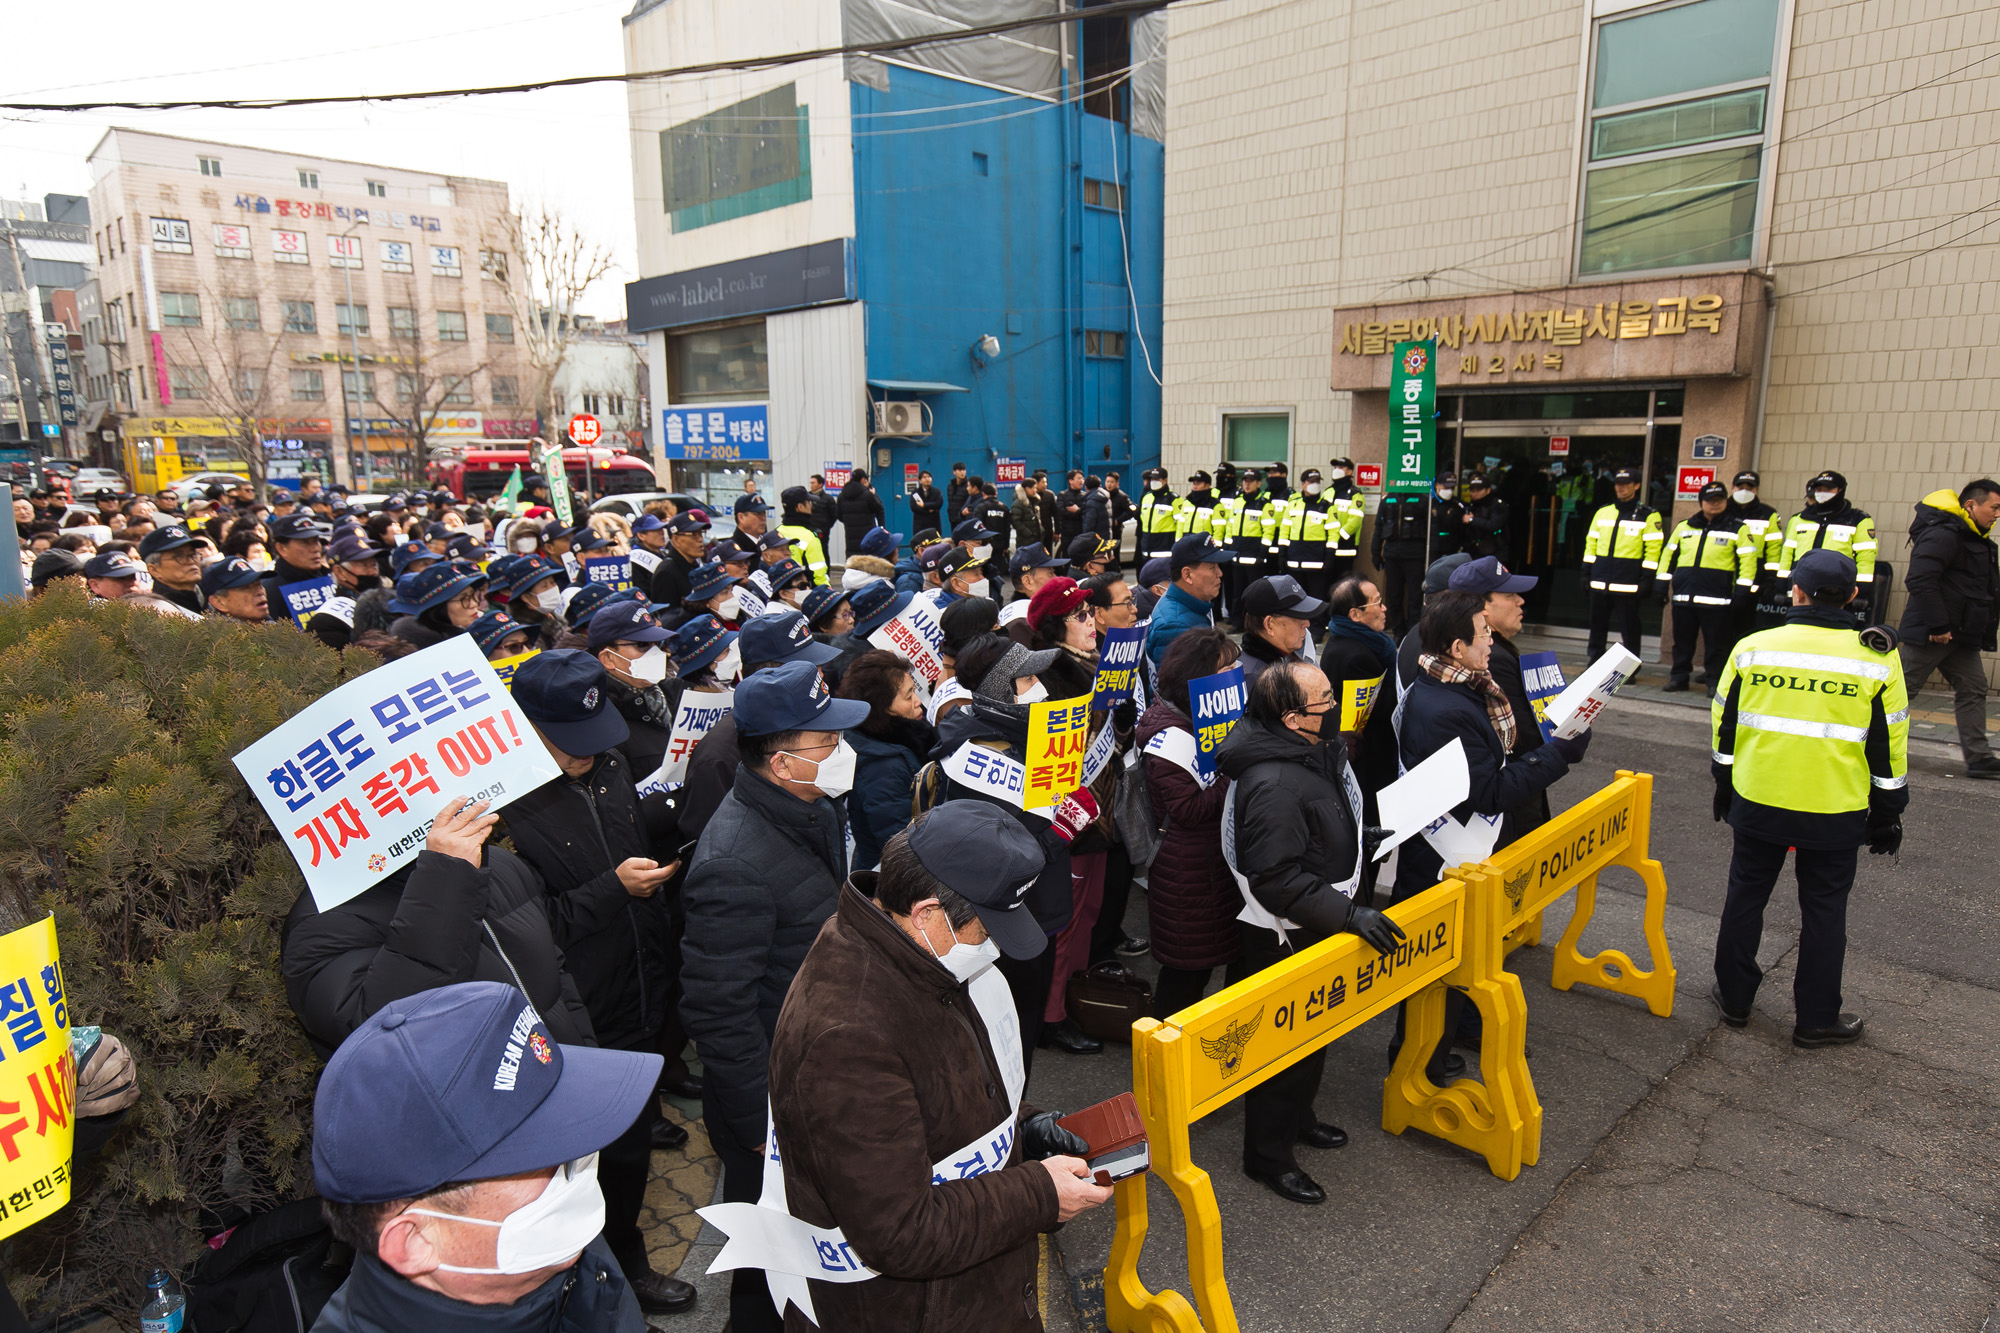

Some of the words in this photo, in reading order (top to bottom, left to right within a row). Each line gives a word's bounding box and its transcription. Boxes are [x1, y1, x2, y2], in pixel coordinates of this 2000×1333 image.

[573, 431, 598, 442] STOP
[666, 411, 726, 445] 솔로몬
[729, 419, 765, 443] 부동산
[1400, 378, 1423, 476] 종로구회
[683, 445, 741, 459] 797-2004
[1703, 446, 1715, 457] 5
[826, 471, 851, 487] 주차금지
[998, 465, 1025, 480] 주차금지
[883, 617, 924, 660] 불법행위
[1104, 641, 1138, 666] 사이비
[1095, 669, 1130, 693] 강력히
[1749, 673, 1860, 699] POLICE
[1198, 682, 1242, 720] 사이비
[266, 717, 377, 814] 한글도
[370, 668, 492, 745] 모르는
[293, 797, 371, 868] 기자
[360, 751, 441, 819] 즉각
[436, 708, 524, 778] OUT!
[1031, 761, 1077, 791] 즉각
[1539, 829, 1596, 889] POLICE
[1600, 807, 1629, 848] LINE
[1274, 1000, 1296, 1032] 이
[1304, 974, 1347, 1023] 선을
[1356, 921, 1448, 995] 넘지마시오
[493, 1041, 525, 1092] KOREAN
